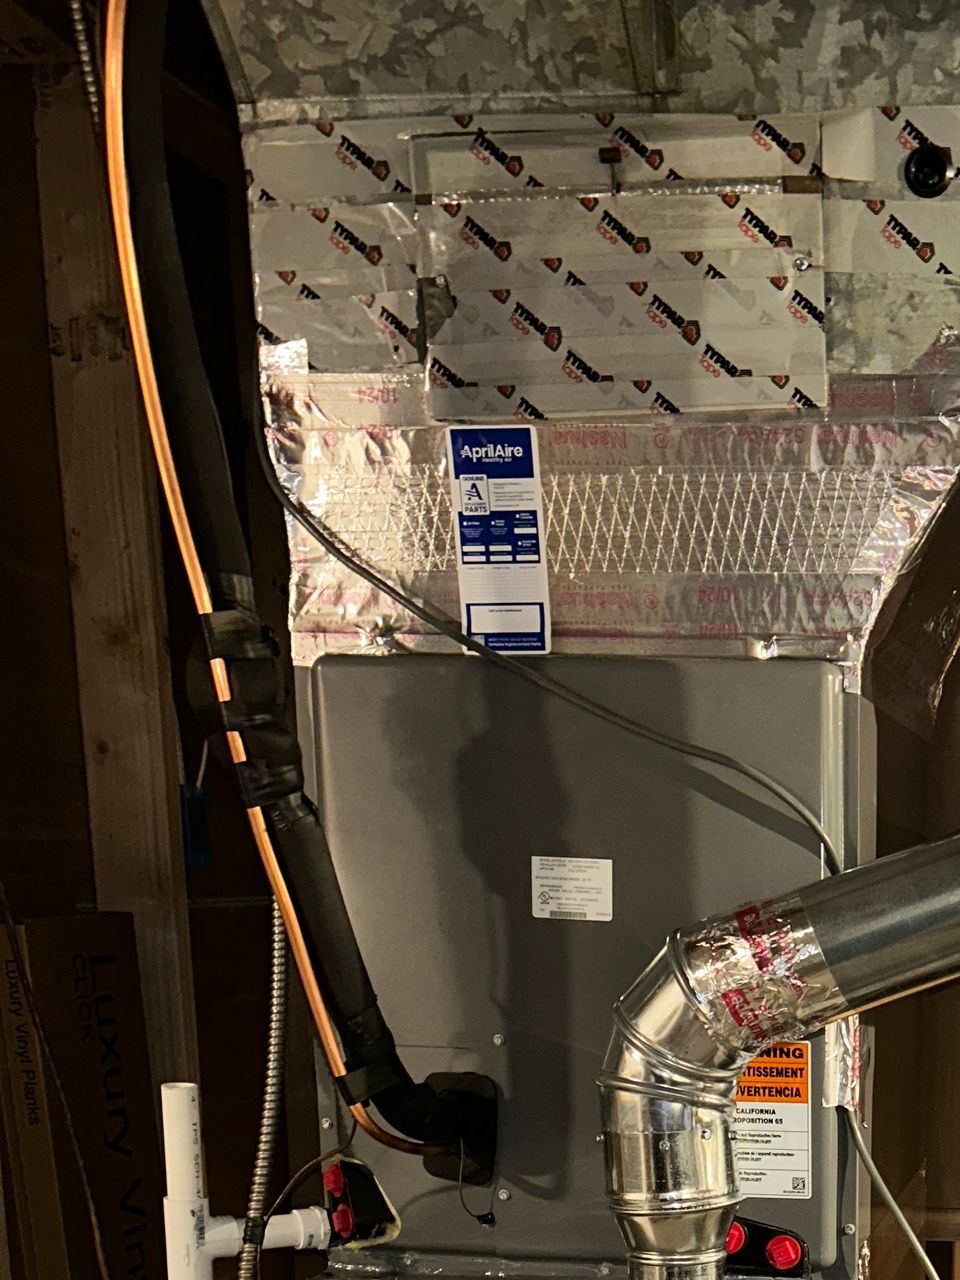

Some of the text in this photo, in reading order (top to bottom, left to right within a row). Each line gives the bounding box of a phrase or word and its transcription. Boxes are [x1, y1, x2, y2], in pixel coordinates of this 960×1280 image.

[755, 120, 790, 157] TYPAR
[901, 119, 932, 147] TYPA
[339, 135, 375, 170] TYPAR
[332, 220, 368, 255] TYPAR
[463, 216, 498, 252] TYPAR
[600, 210, 637, 246] TYPAR
[742, 207, 779, 246] TYPAR
[886, 214, 922, 251] TYPAR
[380, 306, 410, 338] TYPAR
[514, 301, 548, 336] TYPAR
[651, 294, 686, 328] TYPAR
[788, 289, 825, 325] TYPAR
[430, 357, 466, 389] TYPAR
[565, 350, 600, 383] TYPAR
[702, 343, 740, 378] TYPAR
[460, 443, 524, 463] AprilAire
[5, 959, 41, 1127] Luxury Vinyl Planks
[92, 954, 134, 1157] Luxury
[758, 1048, 804, 1059] NING
[742, 1066, 805, 1079] TISSEMENT
[733, 1117, 773, 1125] ROPOSITION
